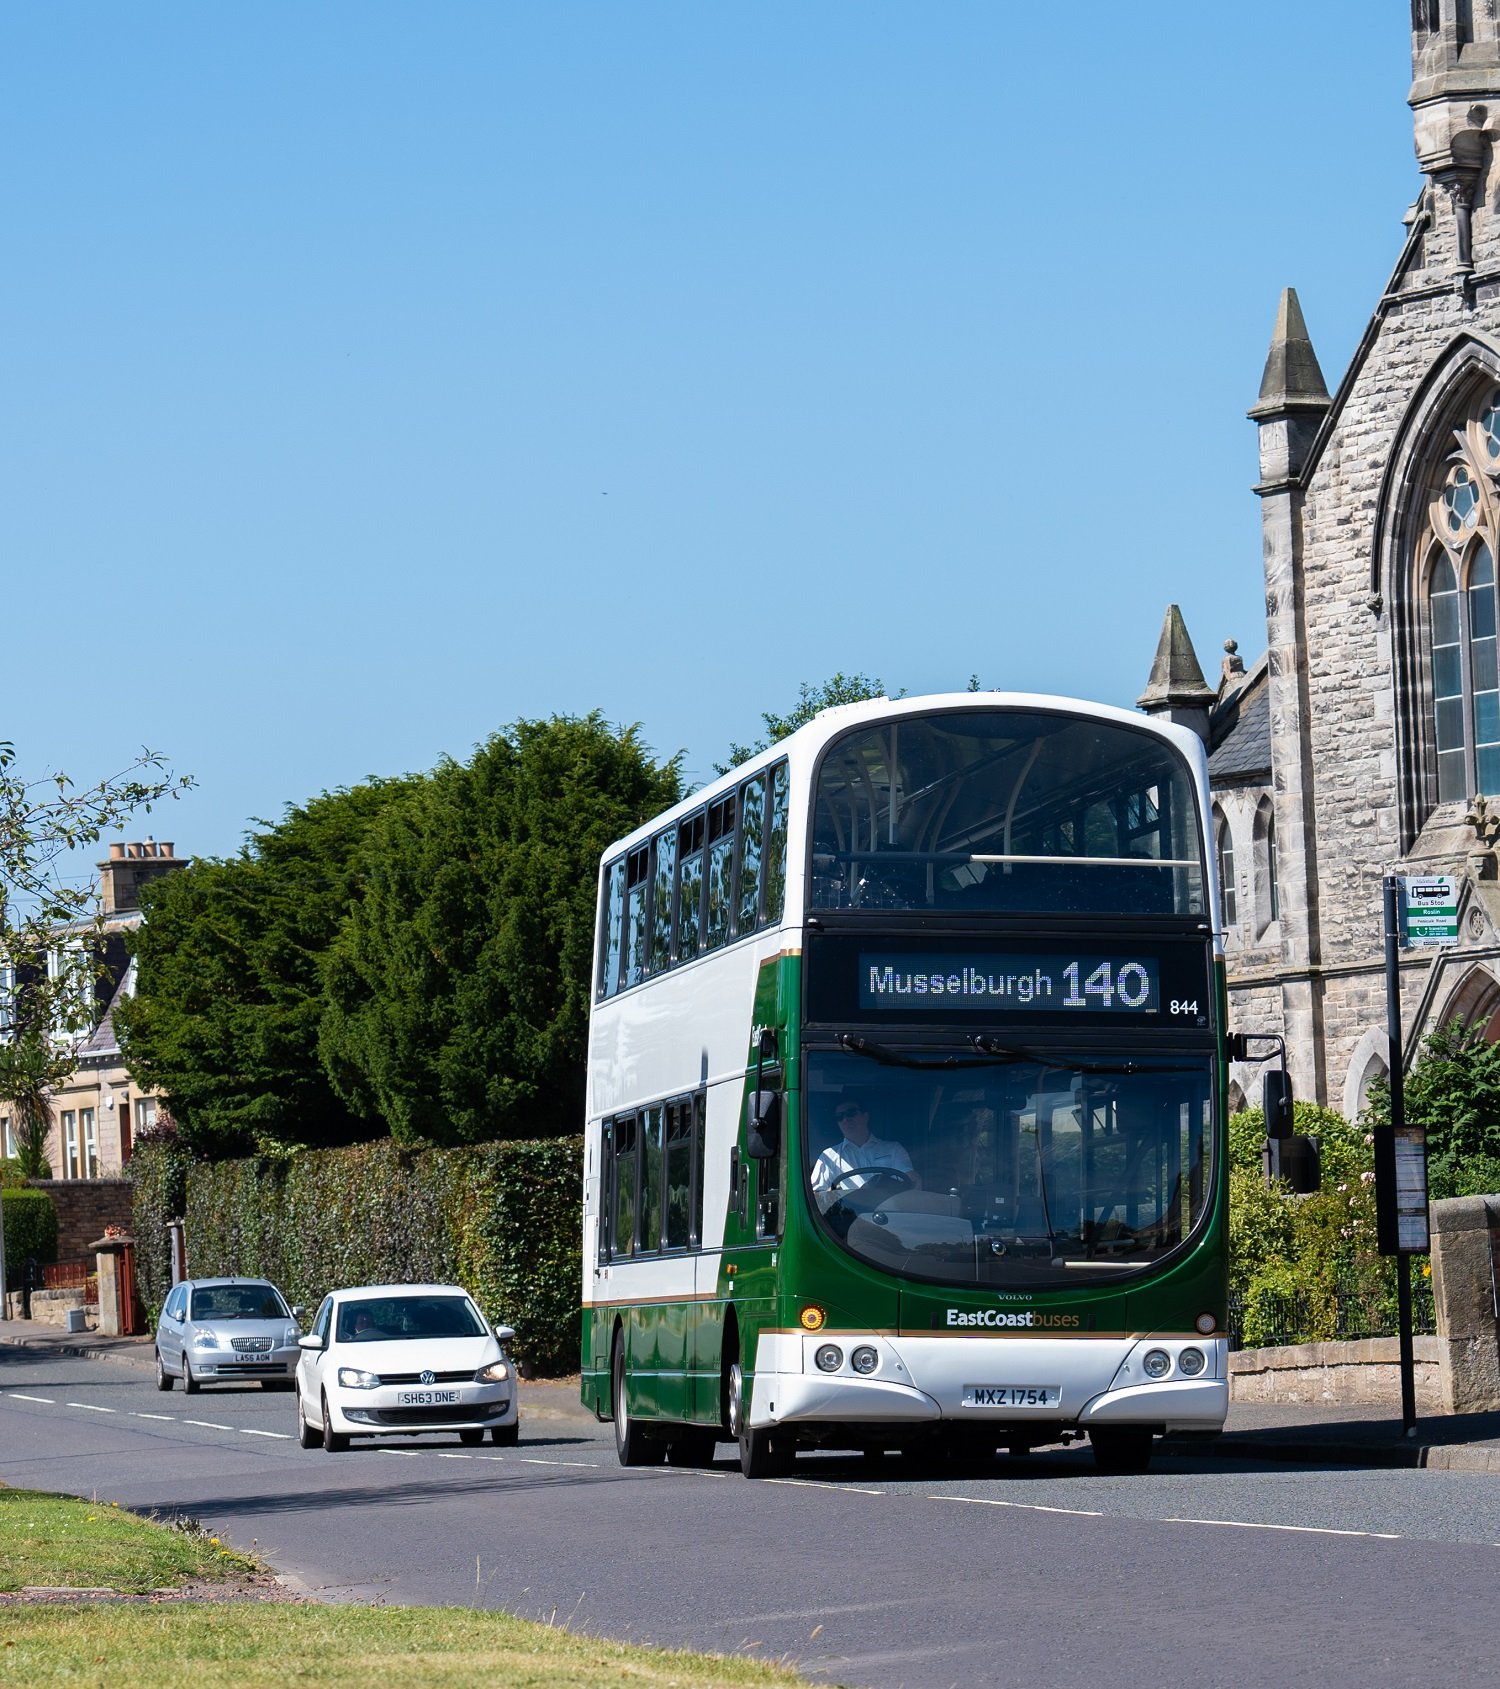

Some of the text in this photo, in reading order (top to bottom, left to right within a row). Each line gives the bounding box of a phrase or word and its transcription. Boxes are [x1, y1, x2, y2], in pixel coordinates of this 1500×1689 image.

[869, 961, 1150, 1007] Musselburgh 140
[1170, 999, 1198, 1015] 844
[403, 1392, 456, 1404] SH63 DNE
[974, 1389, 1048, 1405] MXZ 1754
